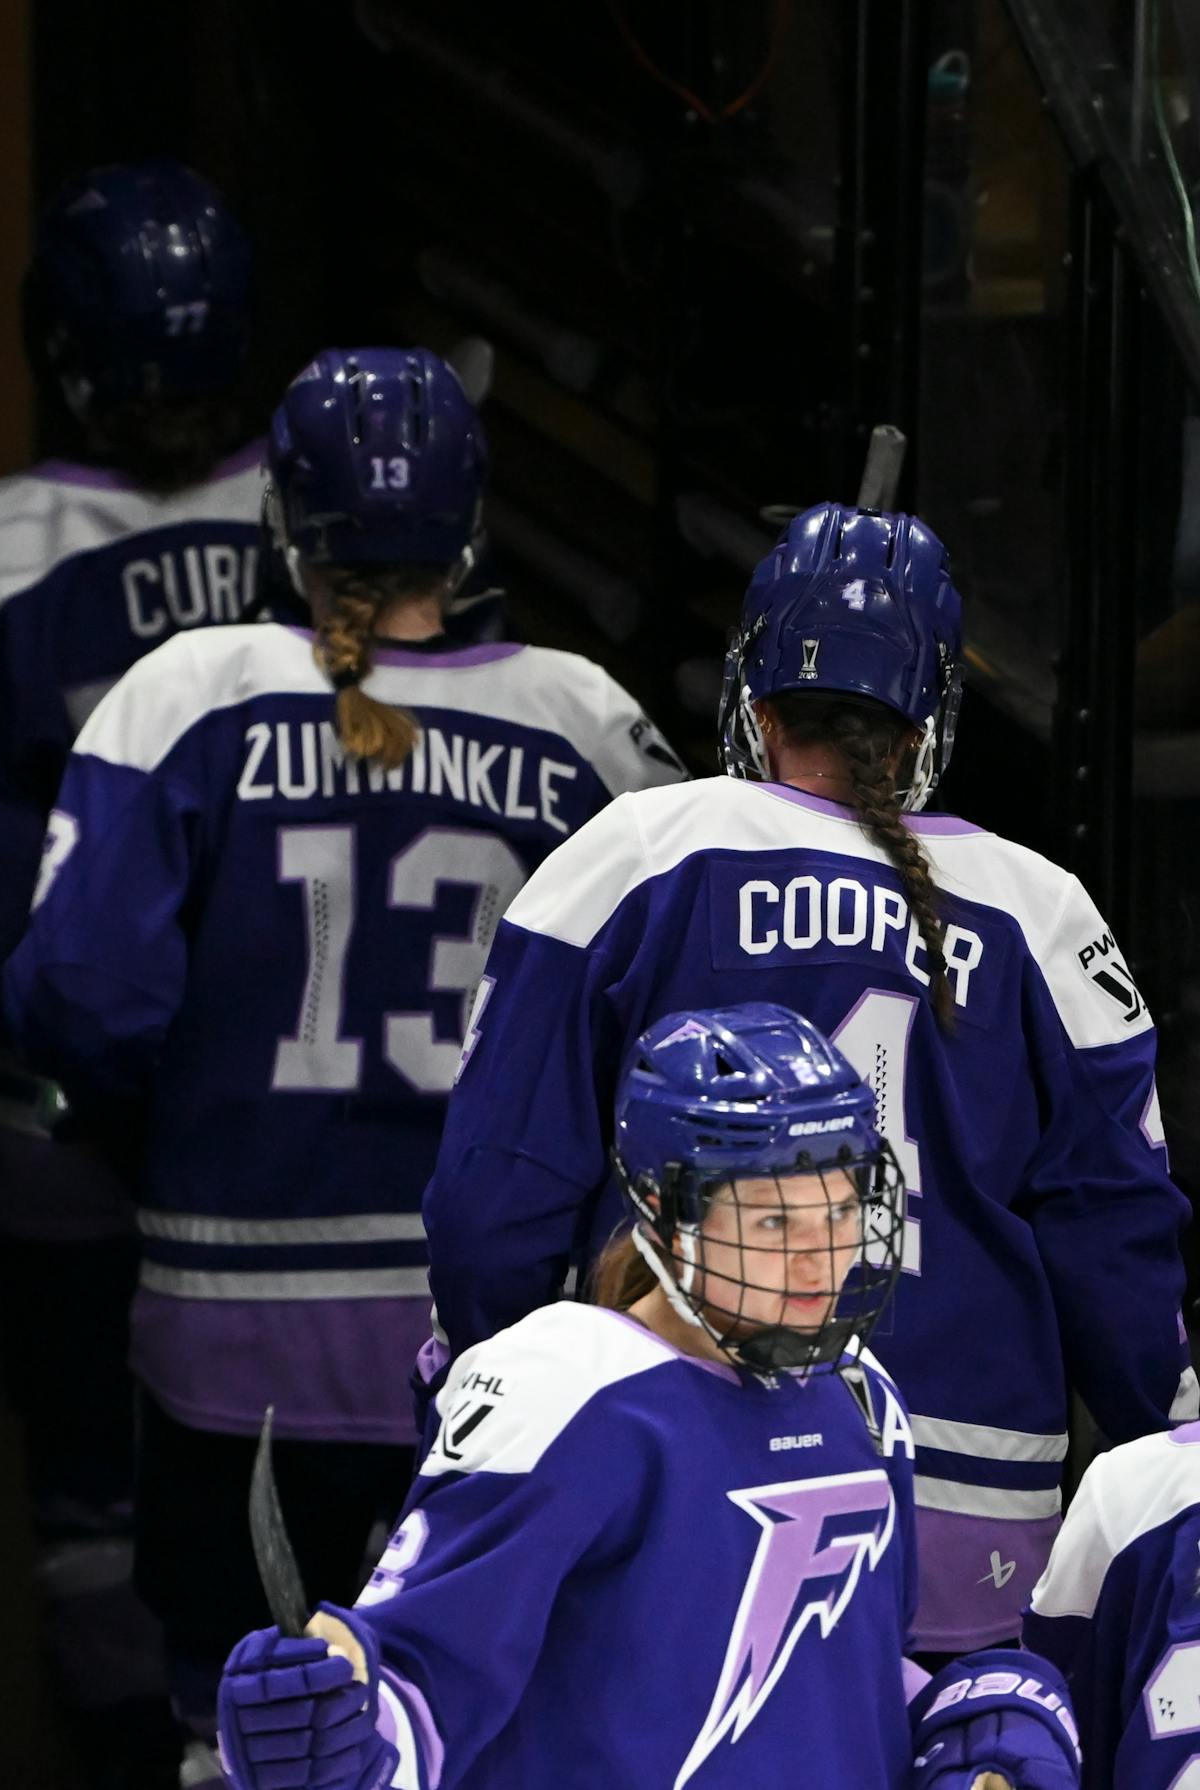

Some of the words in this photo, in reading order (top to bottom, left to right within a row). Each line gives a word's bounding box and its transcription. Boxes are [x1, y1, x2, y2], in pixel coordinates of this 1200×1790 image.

[371, 456, 410, 488] 13
[842, 579, 866, 611] 4
[271, 824, 525, 1093] 13
[739, 876, 983, 1007] COOPER
[1078, 930, 1116, 970] PW
[788, 1116, 856, 1138] BAUER
[875, 1377, 915, 1460] A
[769, 1432, 824, 1452] BAUER
[921, 1671, 1083, 1765] BAU
